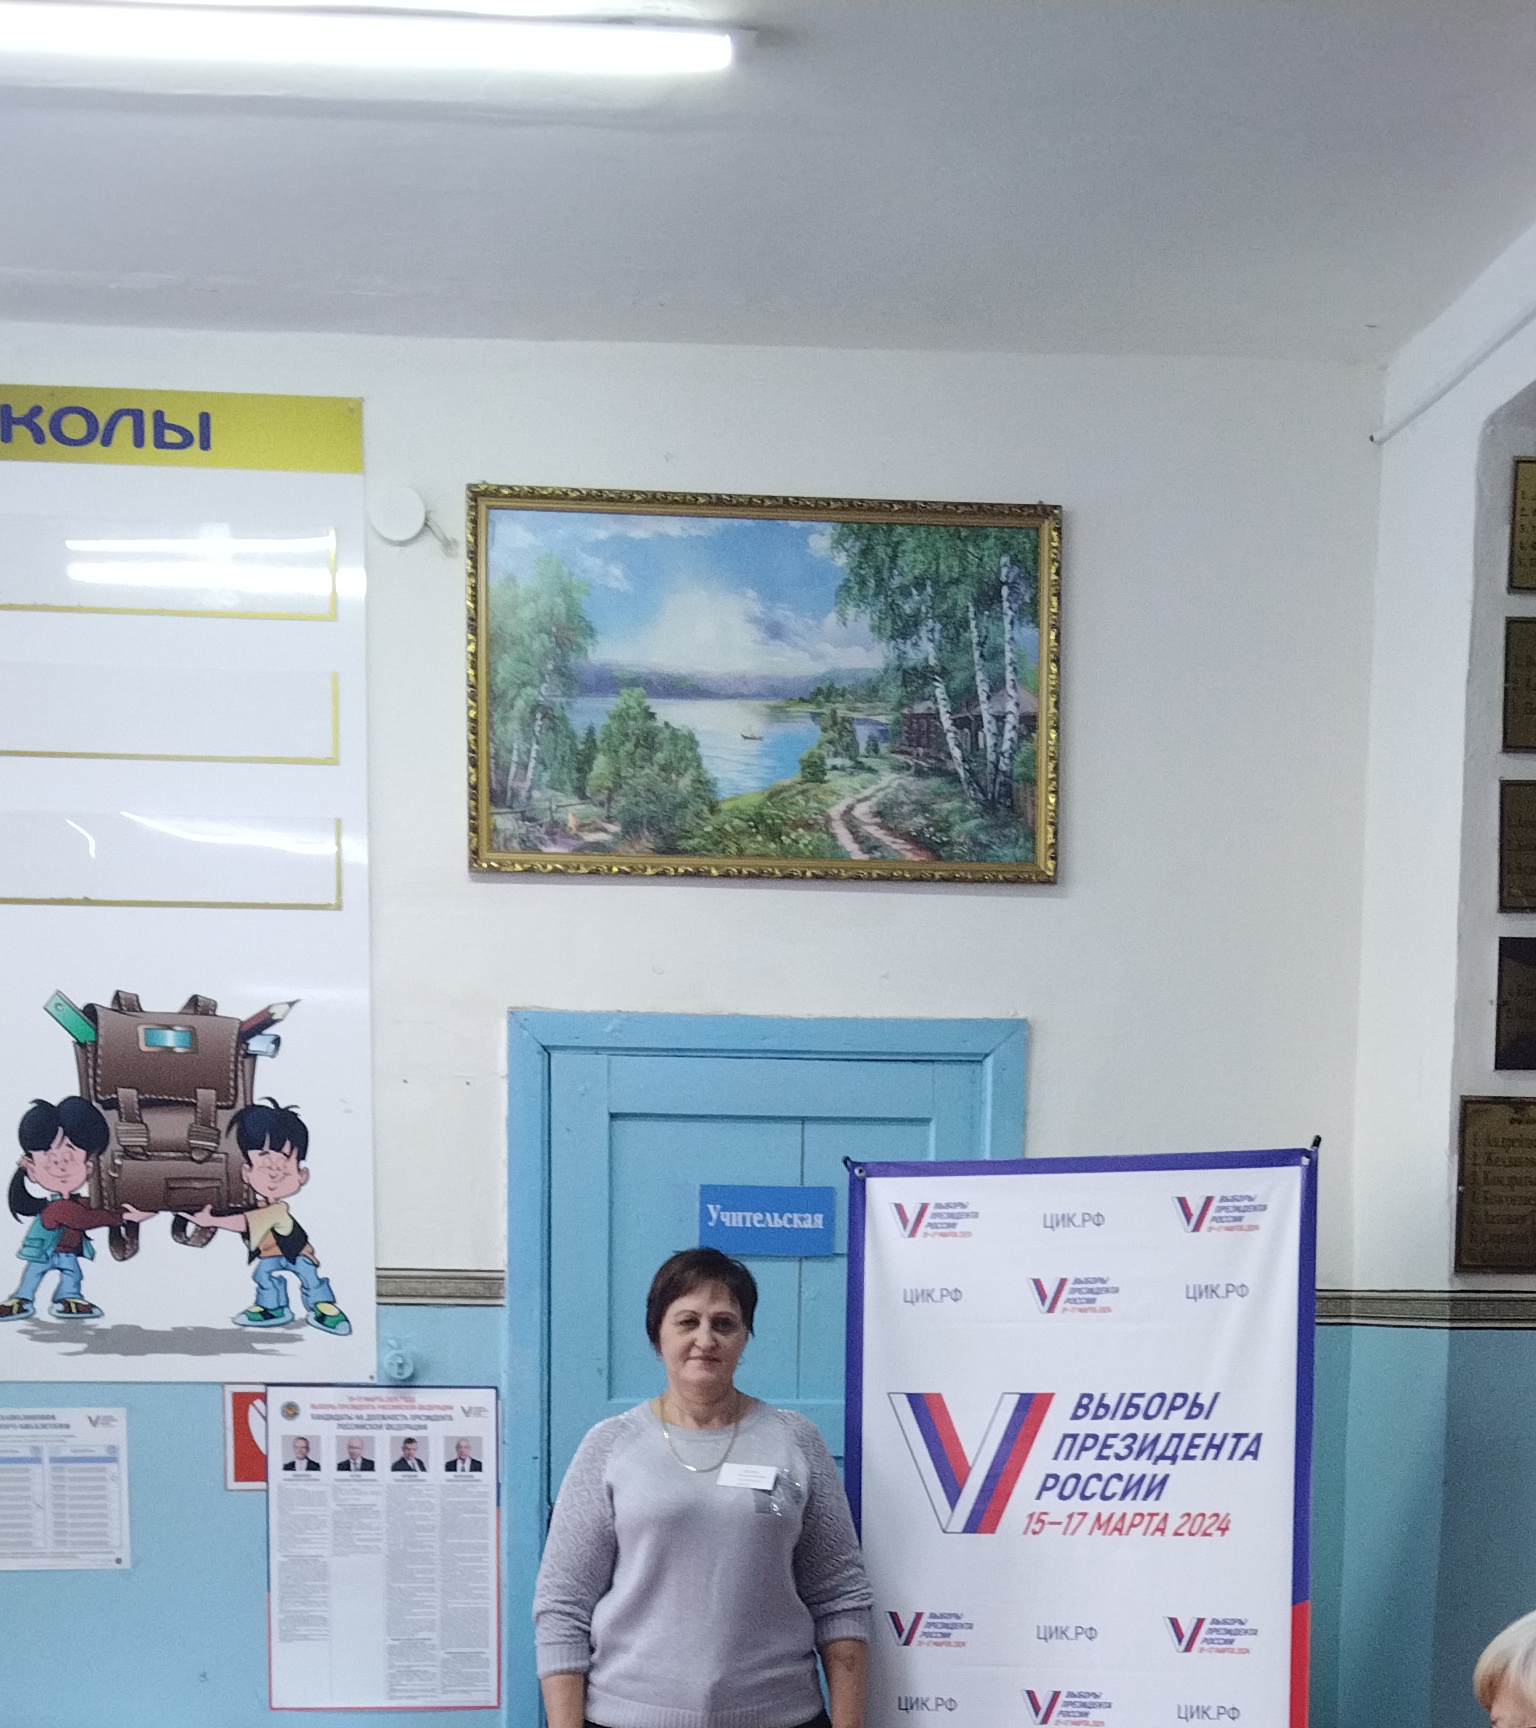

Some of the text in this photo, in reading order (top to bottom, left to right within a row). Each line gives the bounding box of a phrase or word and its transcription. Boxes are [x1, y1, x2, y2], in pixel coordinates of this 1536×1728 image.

[706, 1204, 824, 1229] Учительская
[1042, 1212, 1106, 1231] ЦИК.РФ
[902, 1287, 963, 1306] ЦИК.РФ
[1185, 1283, 1250, 1302] ЦИК.РФ
[1069, 1392, 1221, 1421] ВЫБОРЫ
[1052, 1432, 1263, 1465] ПРЕЗИДЕНТА
[1035, 1473, 1171, 1501] РОССИИ
[1088, 1512, 1169, 1537] МАРТА
[1172, 1512, 1231, 1537] 2024
[1036, 1625, 1098, 1642] ЦИК.РФ
[897, 1696, 958, 1714] ЦИК.РФ
[1176, 1703, 1241, 1723] ЦИК.РФ
